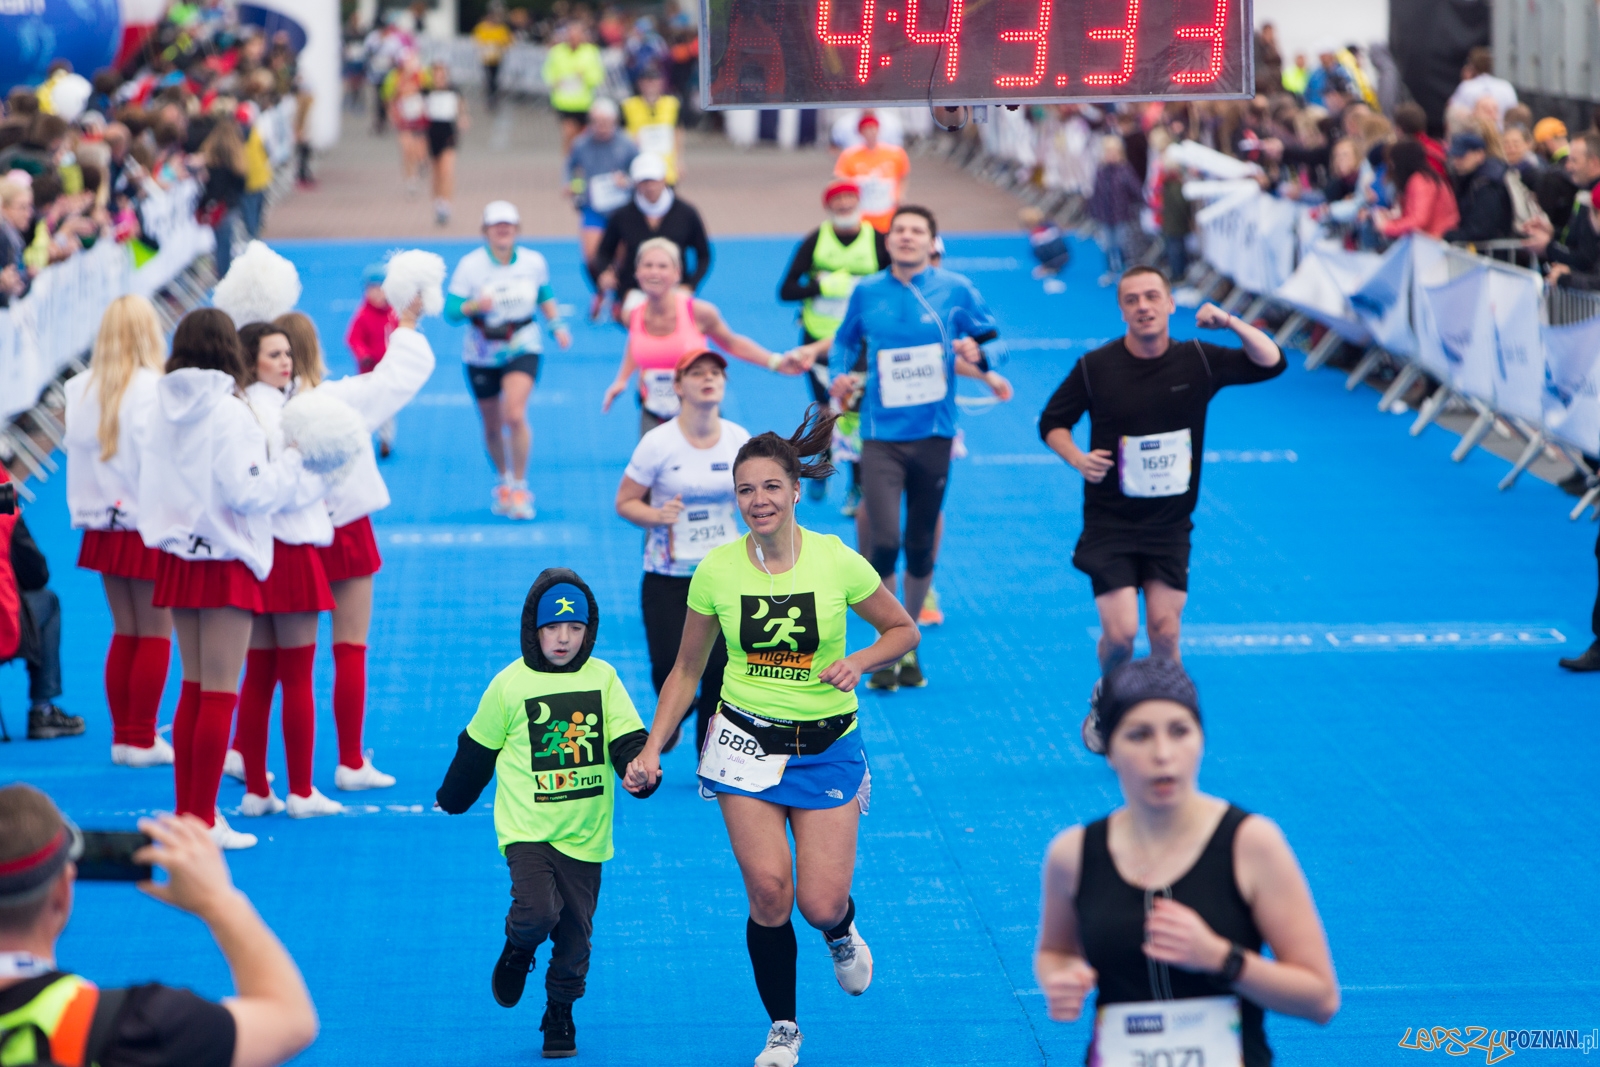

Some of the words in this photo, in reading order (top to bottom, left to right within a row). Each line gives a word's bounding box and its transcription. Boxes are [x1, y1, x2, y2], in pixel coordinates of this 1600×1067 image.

[1141, 454, 1177, 470] 1697
[688, 525, 725, 542] 2974
[745, 664, 810, 681] runners
[727, 754, 745, 765] Julia
[535, 771, 579, 791] KIDS
[581, 774, 602, 786] run
